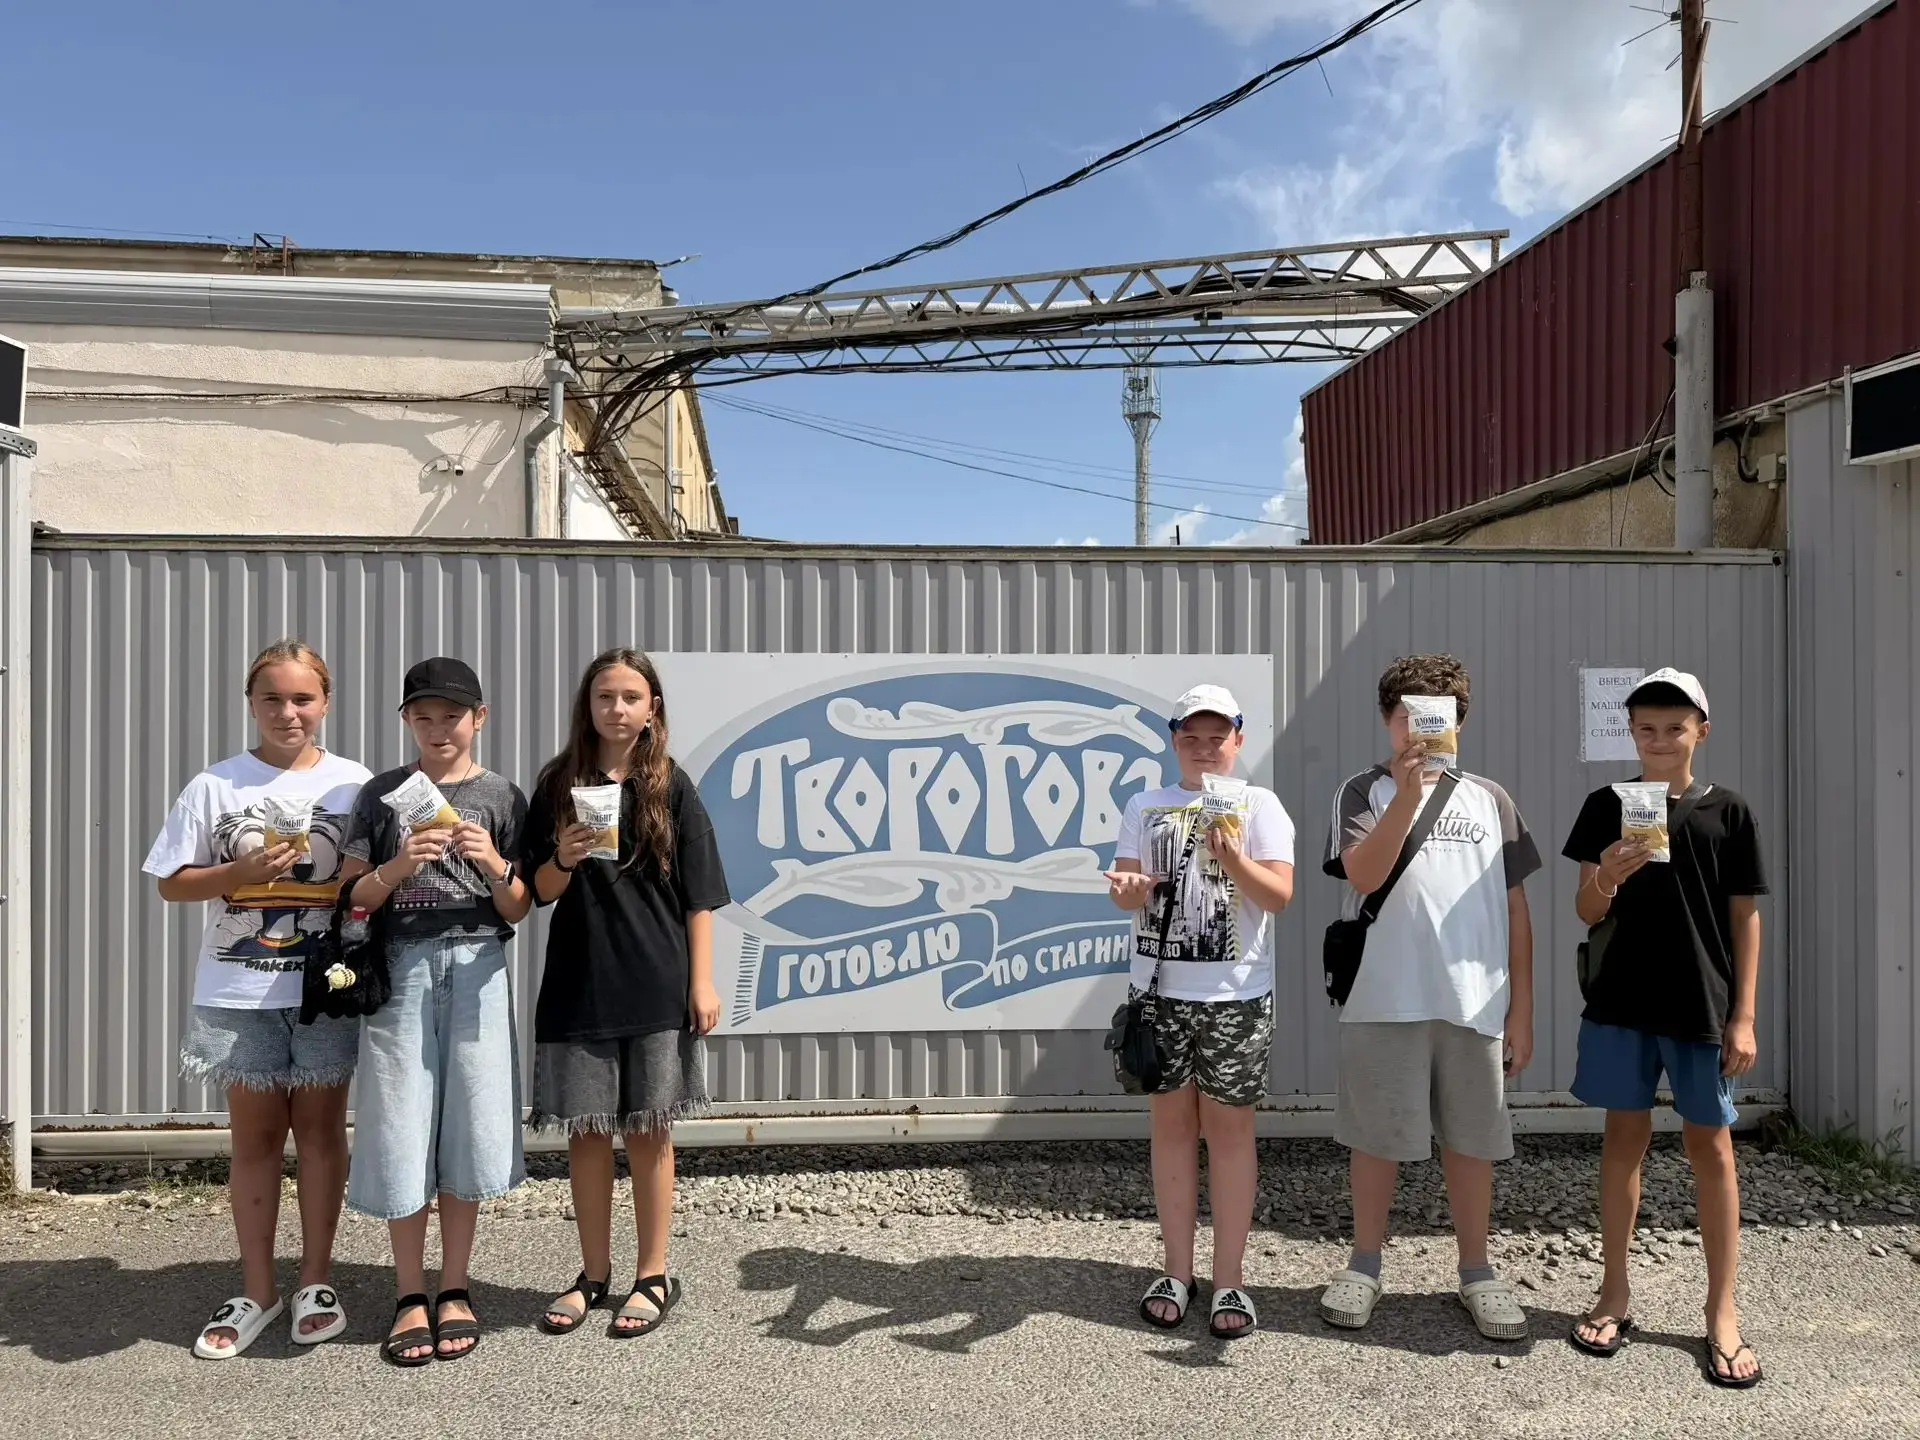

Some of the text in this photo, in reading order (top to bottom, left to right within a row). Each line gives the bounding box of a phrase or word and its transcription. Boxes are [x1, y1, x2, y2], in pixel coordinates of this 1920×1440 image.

[1598, 677, 1631, 687] ВЫЕЗД
[1591, 701, 1627, 710] МАШИ
[1606, 716, 1620, 725] НЕ
[1591, 728, 1631, 738] СТАВИТ
[777, 921, 961, 999] ГОТОВЛЮ
[993, 934, 1132, 987] ПО СТАРИН
[1151, 1289, 1177, 1298] adidas
[1218, 1299, 1246, 1310] adidas
